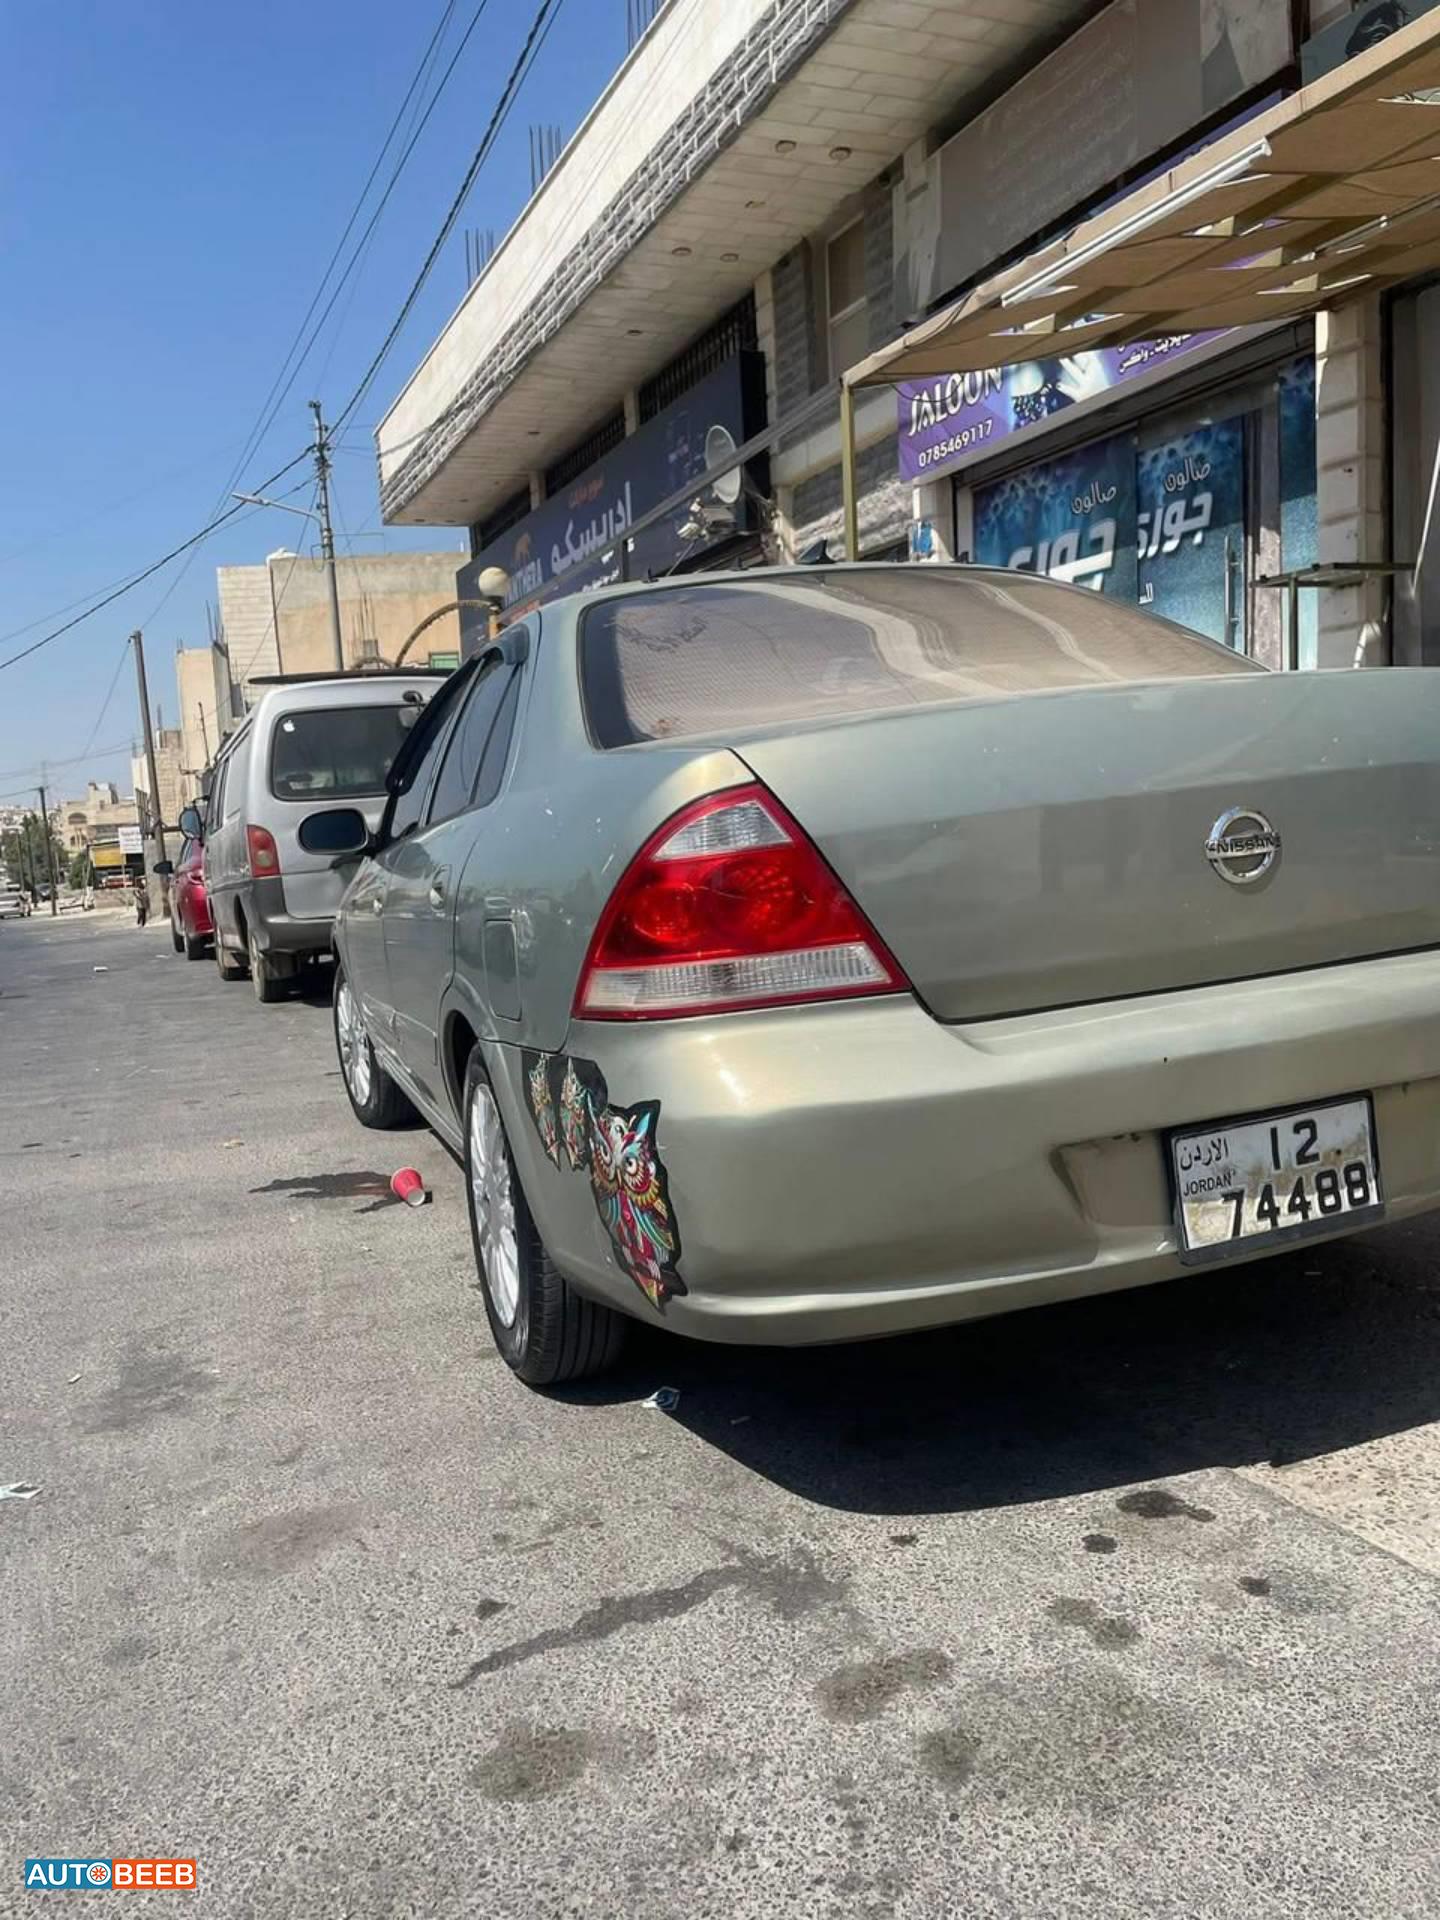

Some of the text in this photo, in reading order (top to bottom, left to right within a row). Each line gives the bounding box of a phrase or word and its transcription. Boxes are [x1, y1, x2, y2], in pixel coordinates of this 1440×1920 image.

[919, 419, 993, 467] 0785469117
[1164, 456, 1211, 492] صالون
[1071, 481, 1117, 514] صالون
[1217, 837, 1273, 854] NISSAN
[1269, 1119, 1320, 1170] 12
[1183, 1175, 1232, 1196] JORDAN
[1221, 1162, 1370, 1237] 74488
